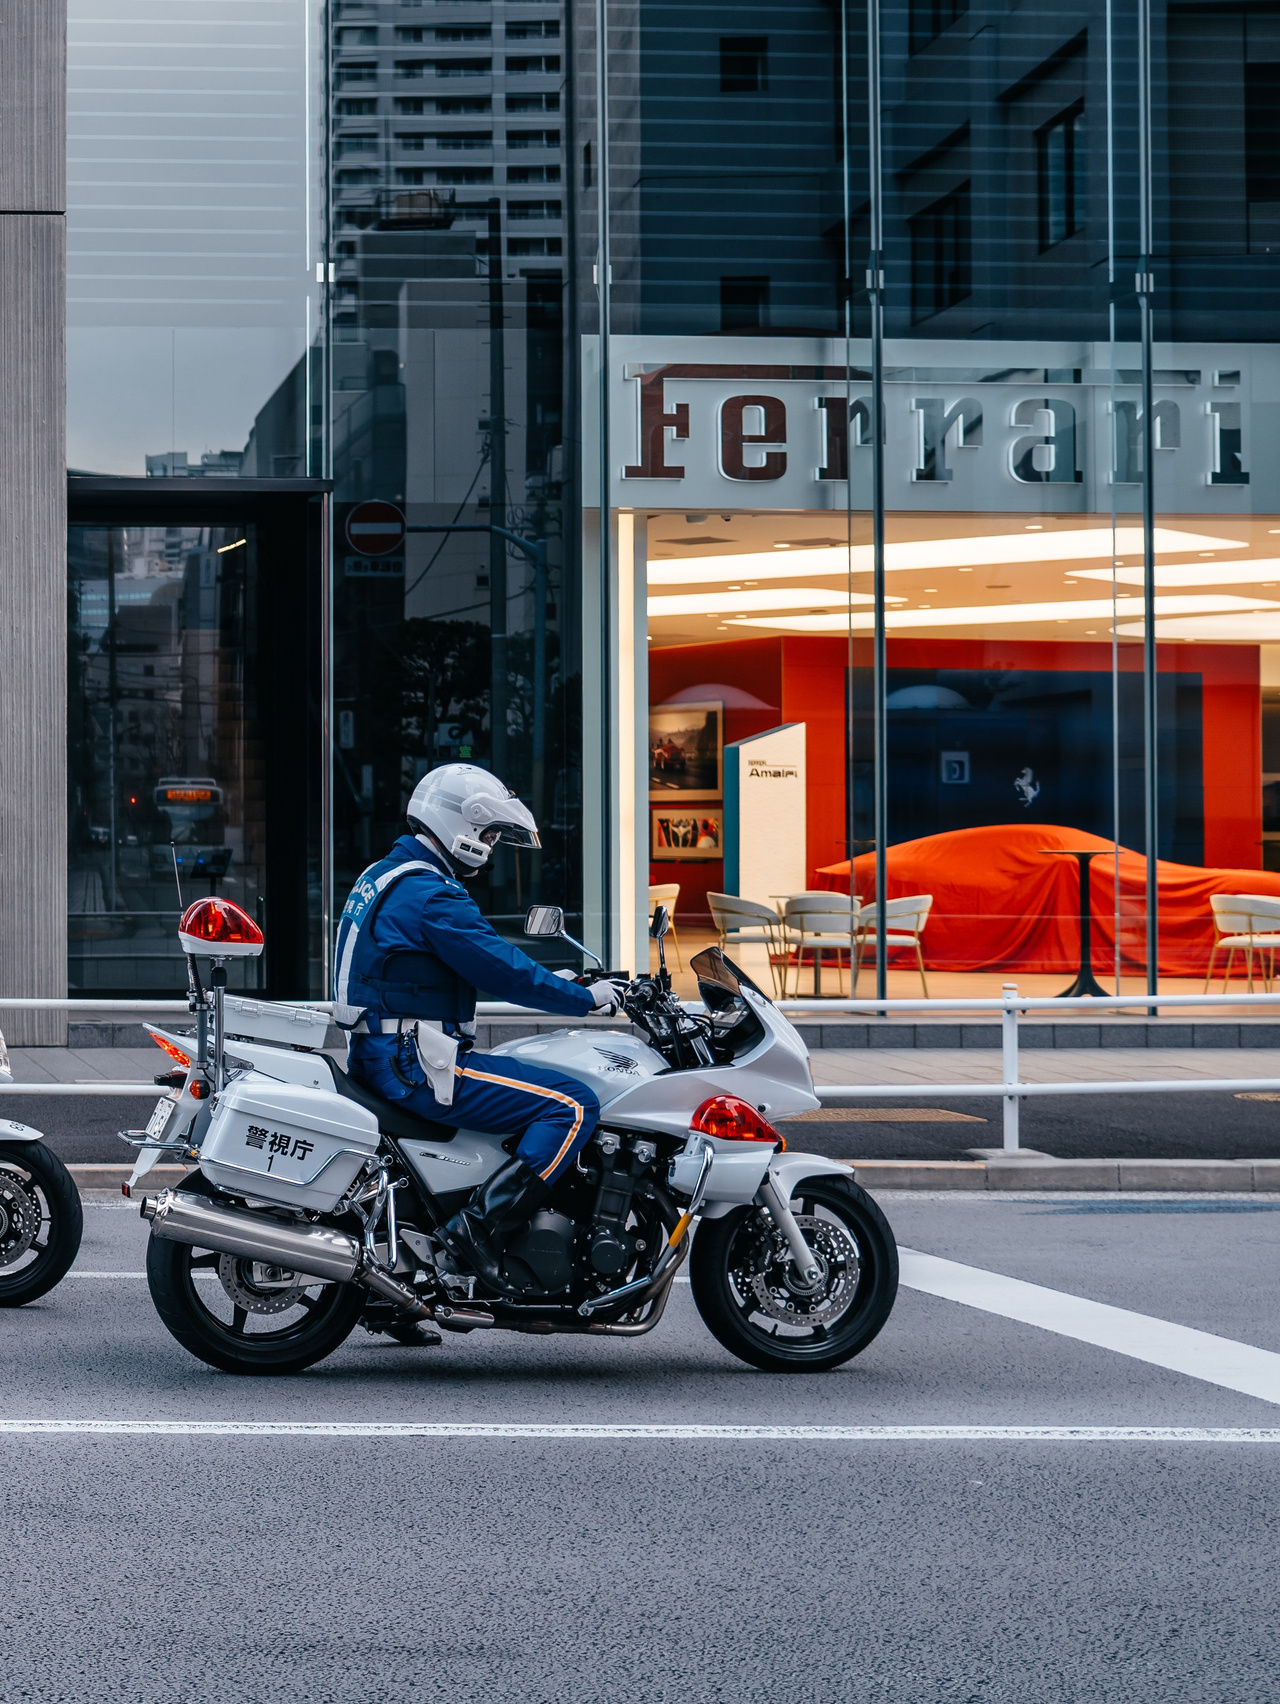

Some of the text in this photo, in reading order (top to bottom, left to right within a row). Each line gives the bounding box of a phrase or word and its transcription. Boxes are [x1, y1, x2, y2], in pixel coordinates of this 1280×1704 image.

[621, 363, 1250, 486] Ferrari
[245, 1125, 315, 1161] 警視庁
[267, 1154, 275, 1172] 1
